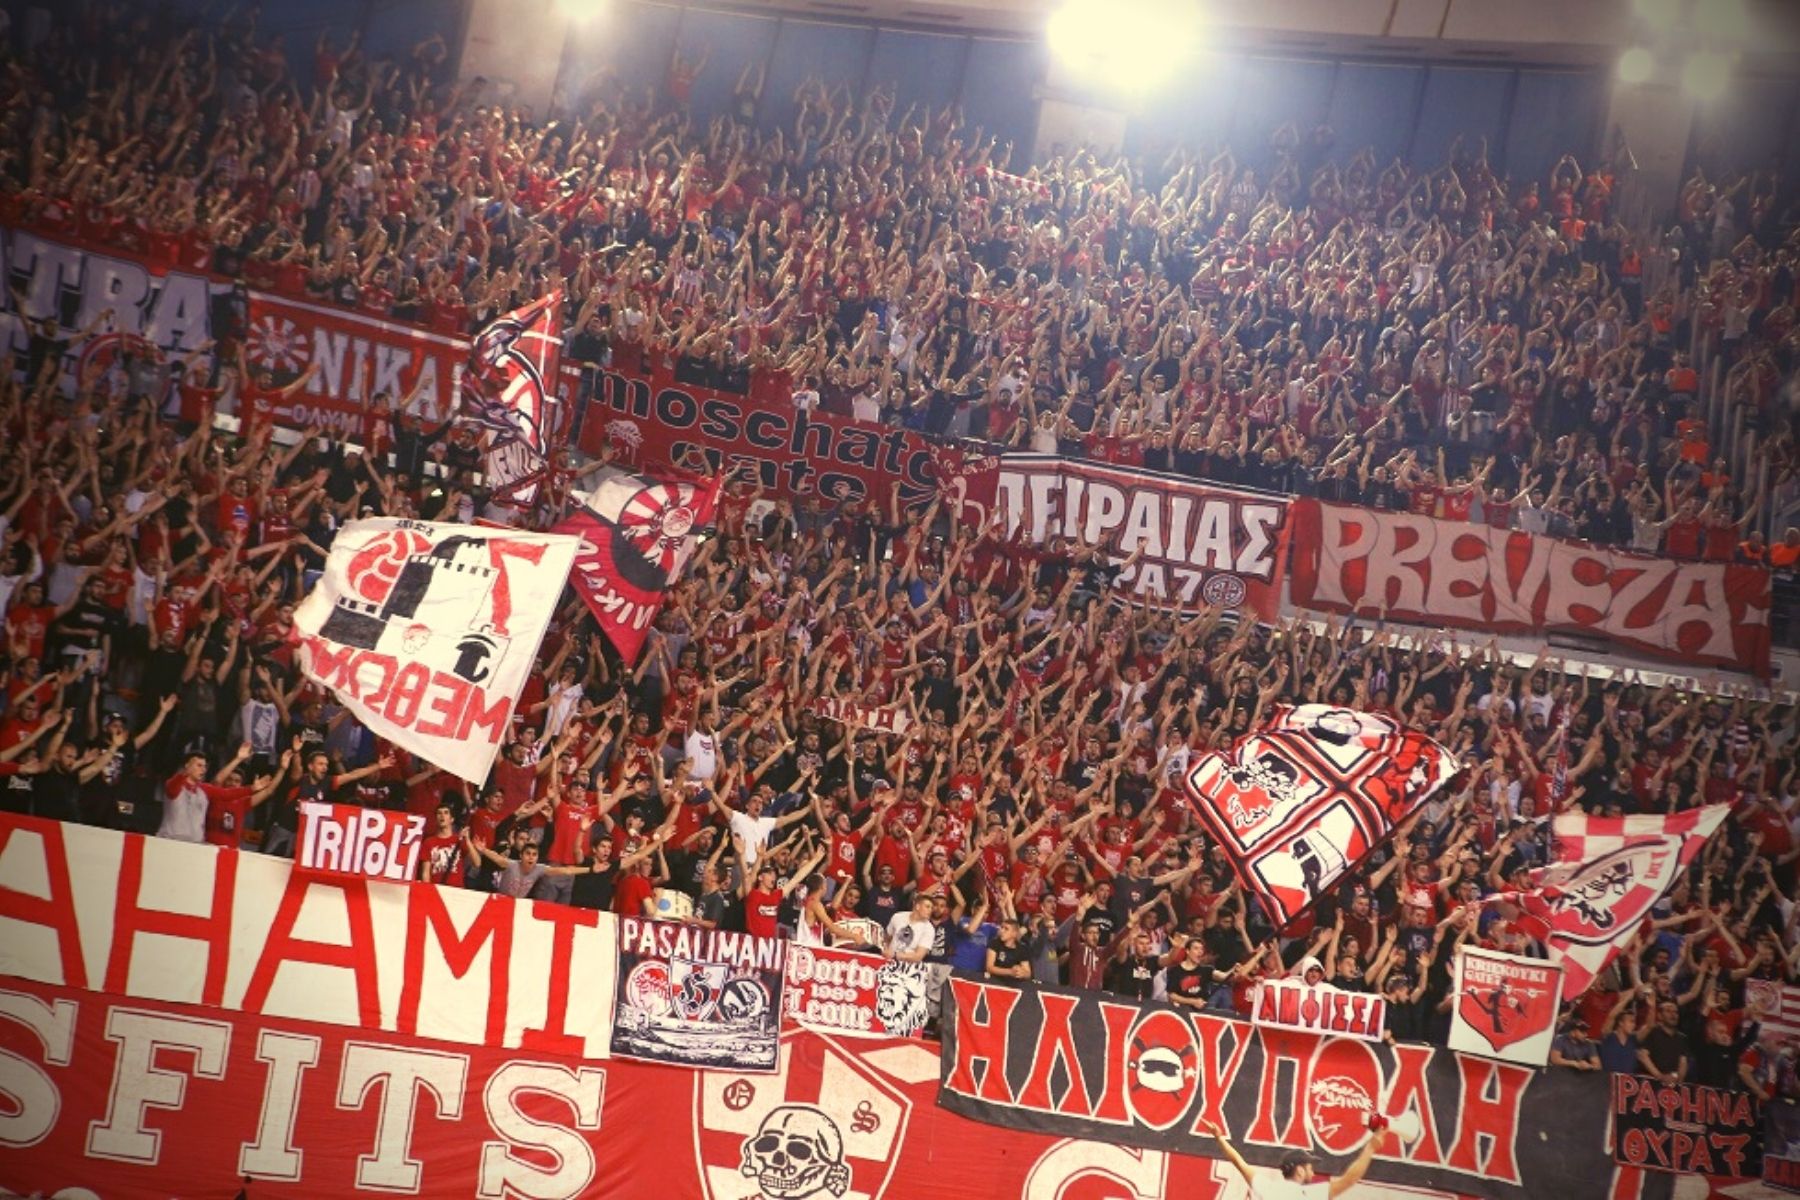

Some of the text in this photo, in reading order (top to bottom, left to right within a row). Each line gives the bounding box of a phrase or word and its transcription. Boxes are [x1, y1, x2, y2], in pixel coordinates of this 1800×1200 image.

[0, 230, 212, 350] TRA
[1311, 501, 1738, 661] PREVEZA
[623, 918, 783, 970] PASALIMANI
[788, 949, 876, 990] Porto
[784, 985, 873, 1030] Leone
[0, 988, 606, 1200] SFITS
[944, 976, 1536, 1186] ΗΛΙΟΥΠΟΛΗ
[1617, 1074, 1755, 1127] ΡΑΦΗΝΑ
